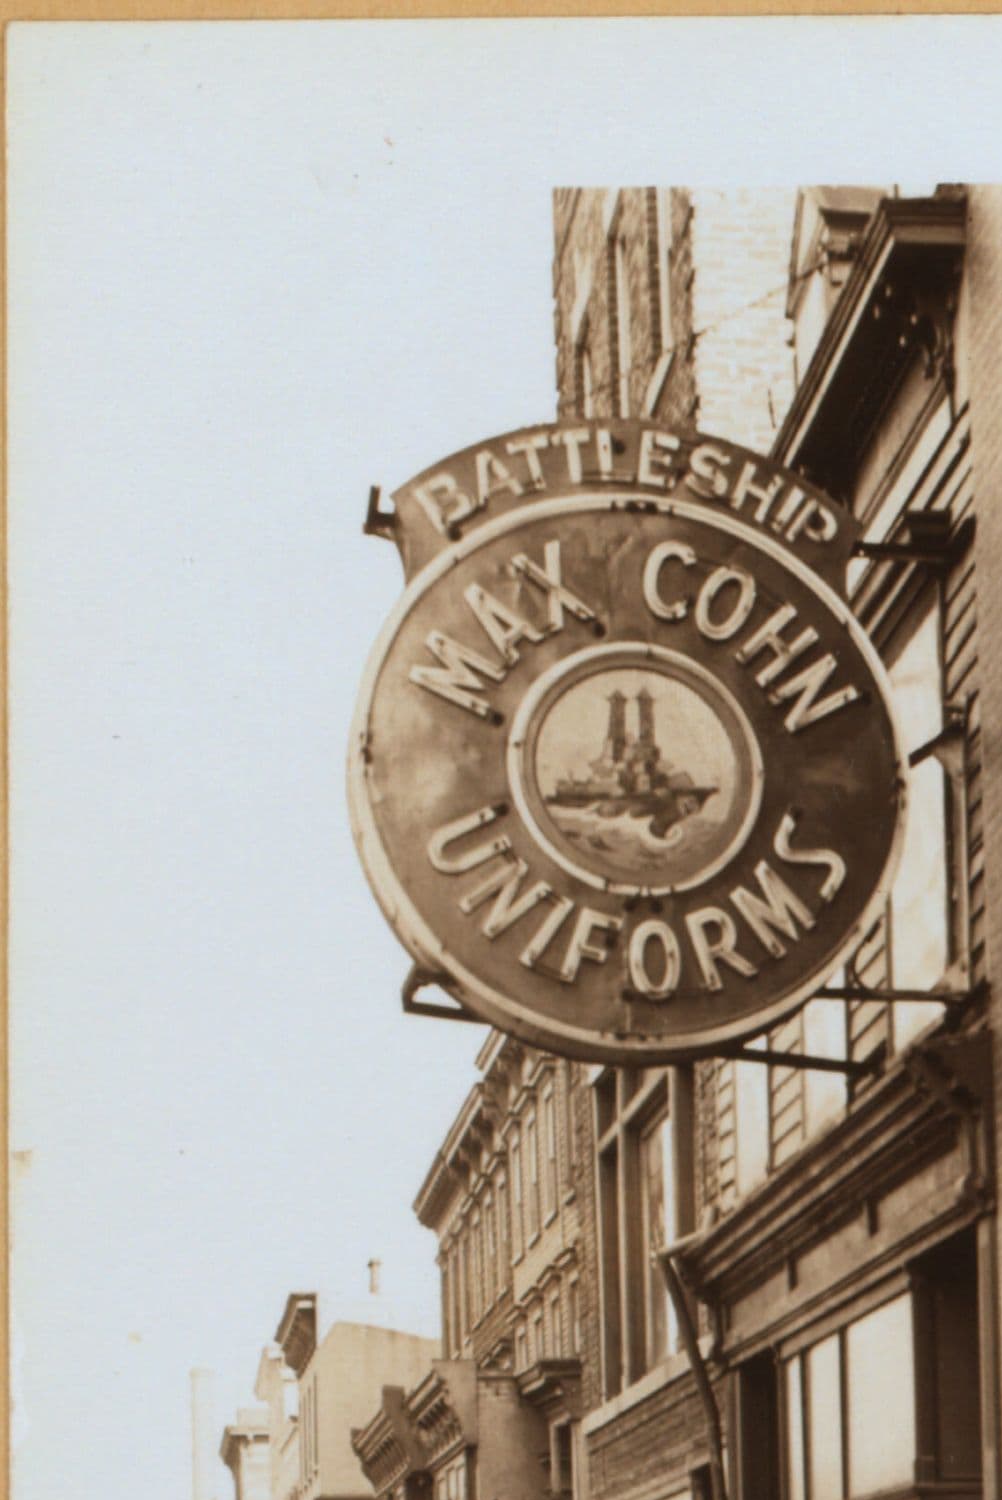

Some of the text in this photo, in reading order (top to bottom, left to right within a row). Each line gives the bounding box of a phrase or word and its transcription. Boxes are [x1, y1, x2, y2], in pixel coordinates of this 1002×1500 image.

[414, 427, 839, 544] BATTLESHIP
[408, 540, 858, 733] MAX COHN
[429, 806, 846, 999] UNIFORMS
